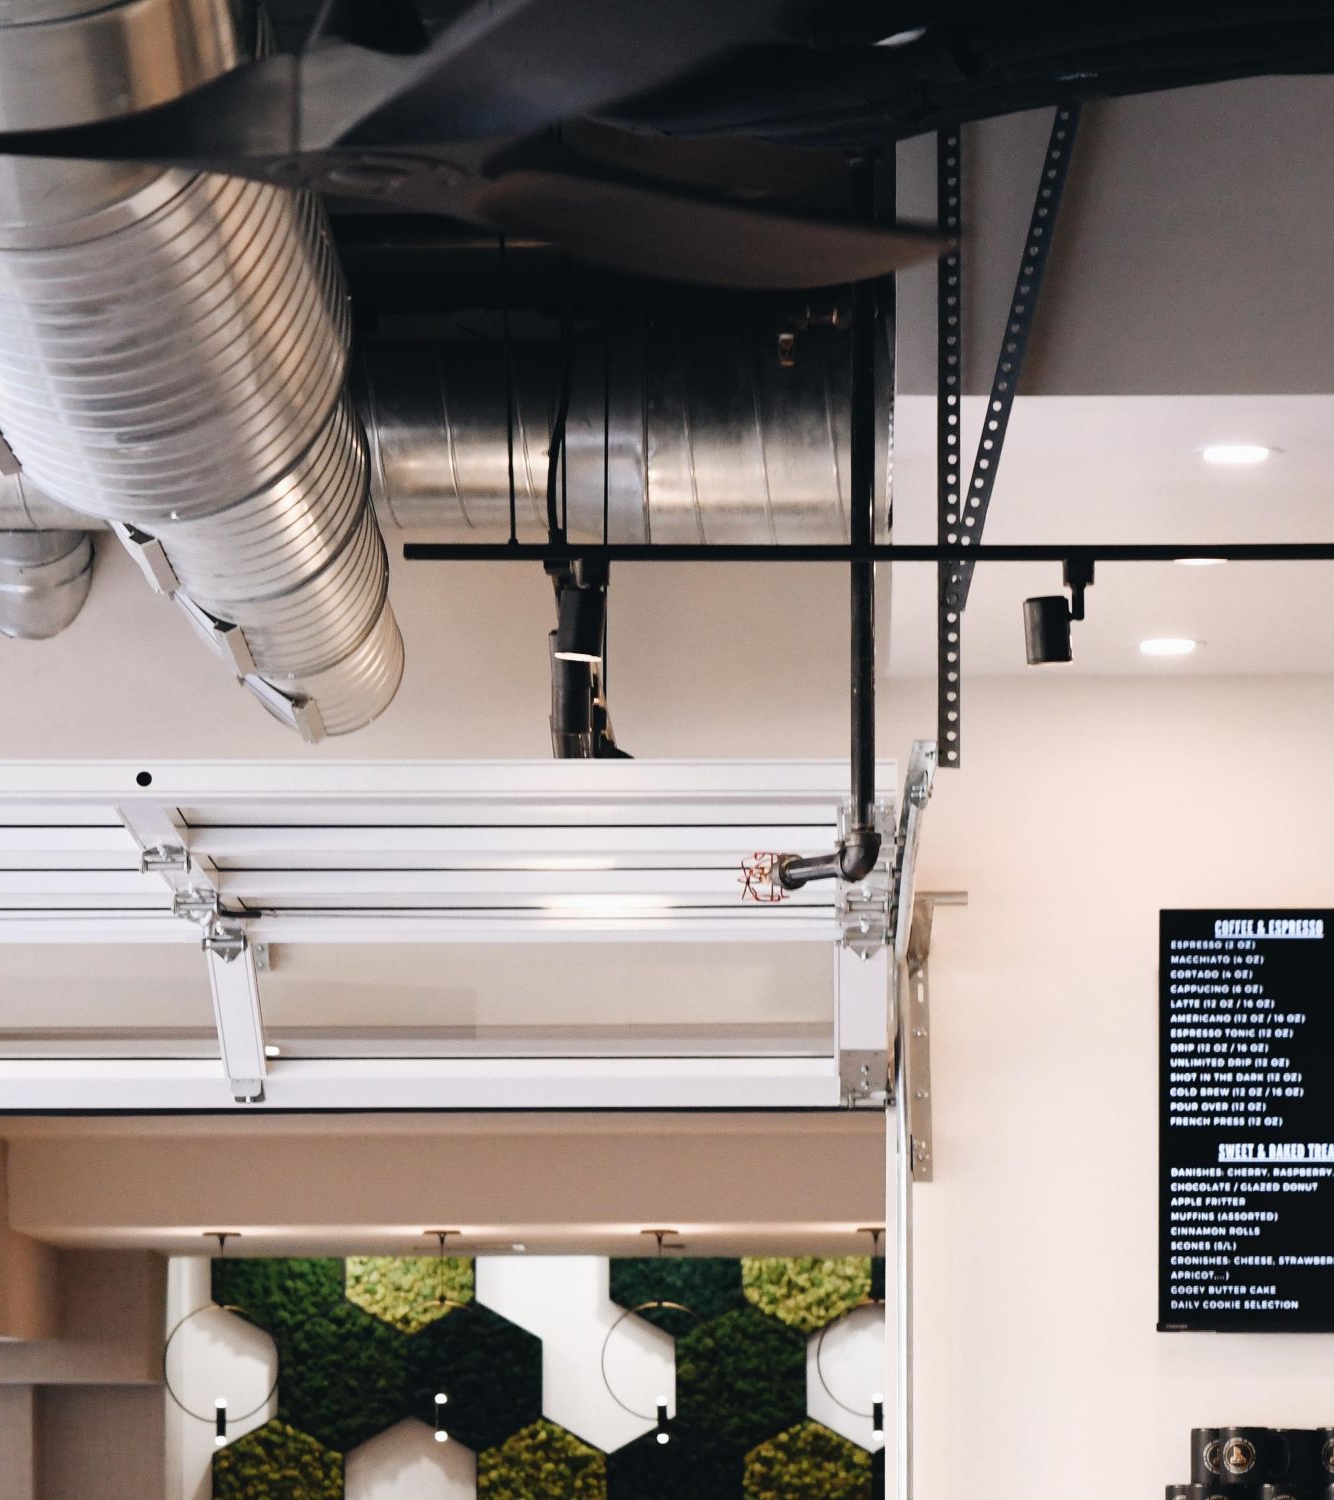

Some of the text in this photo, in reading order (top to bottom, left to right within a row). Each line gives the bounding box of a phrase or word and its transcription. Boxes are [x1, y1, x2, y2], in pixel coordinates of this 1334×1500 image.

[1214, 919, 1254, 934] COFFEE
[1268, 919, 1324, 934] ESPRESSO
[1171, 940, 1223, 950] ESPRESSO
[1237, 940, 1256, 950] OZ)
[1171, 954, 1231, 964] MACCHIATO
[1245, 954, 1264, 965] OZ)
[1170, 969, 1219, 979] CORTADO
[1234, 969, 1253, 980] OZ)
[1170, 984, 1229, 994] CAPPUCINO
[1244, 984, 1263, 994] OZ)
[1170, 1028, 1294, 1038] ESPRESSO TONIC (12 OZ)
[1170, 1072, 1302, 1083] SHOT IN THE DARK (12 OZ)
[1170, 1102, 1267, 1112] POUR OVER (12 OZ)
[1170, 1116, 1283, 1127] FRENCH PRESS (12 OZ)
[1218, 1143, 1255, 1158] SWEET
[1268, 1143, 1305, 1158] BAKED
[1170, 1182, 1231, 1192] CHOCOLATE
[1240, 1182, 1281, 1192] GLAZED
[1282, 1182, 1318, 1192] DONUT
[1171, 1196, 1246, 1206] APPLE FRITTER
[1171, 1211, 1279, 1222] MUFFINS (ASSORTED)
[1170, 1226, 1260, 1236] CINNAMON ROLLS
[1171, 1241, 1211, 1251] SCONES
[1170, 1285, 1276, 1295] GOOEY BUTTER CAKE
[1171, 1300, 1299, 1310] DAILY COOKIE SELECTION
